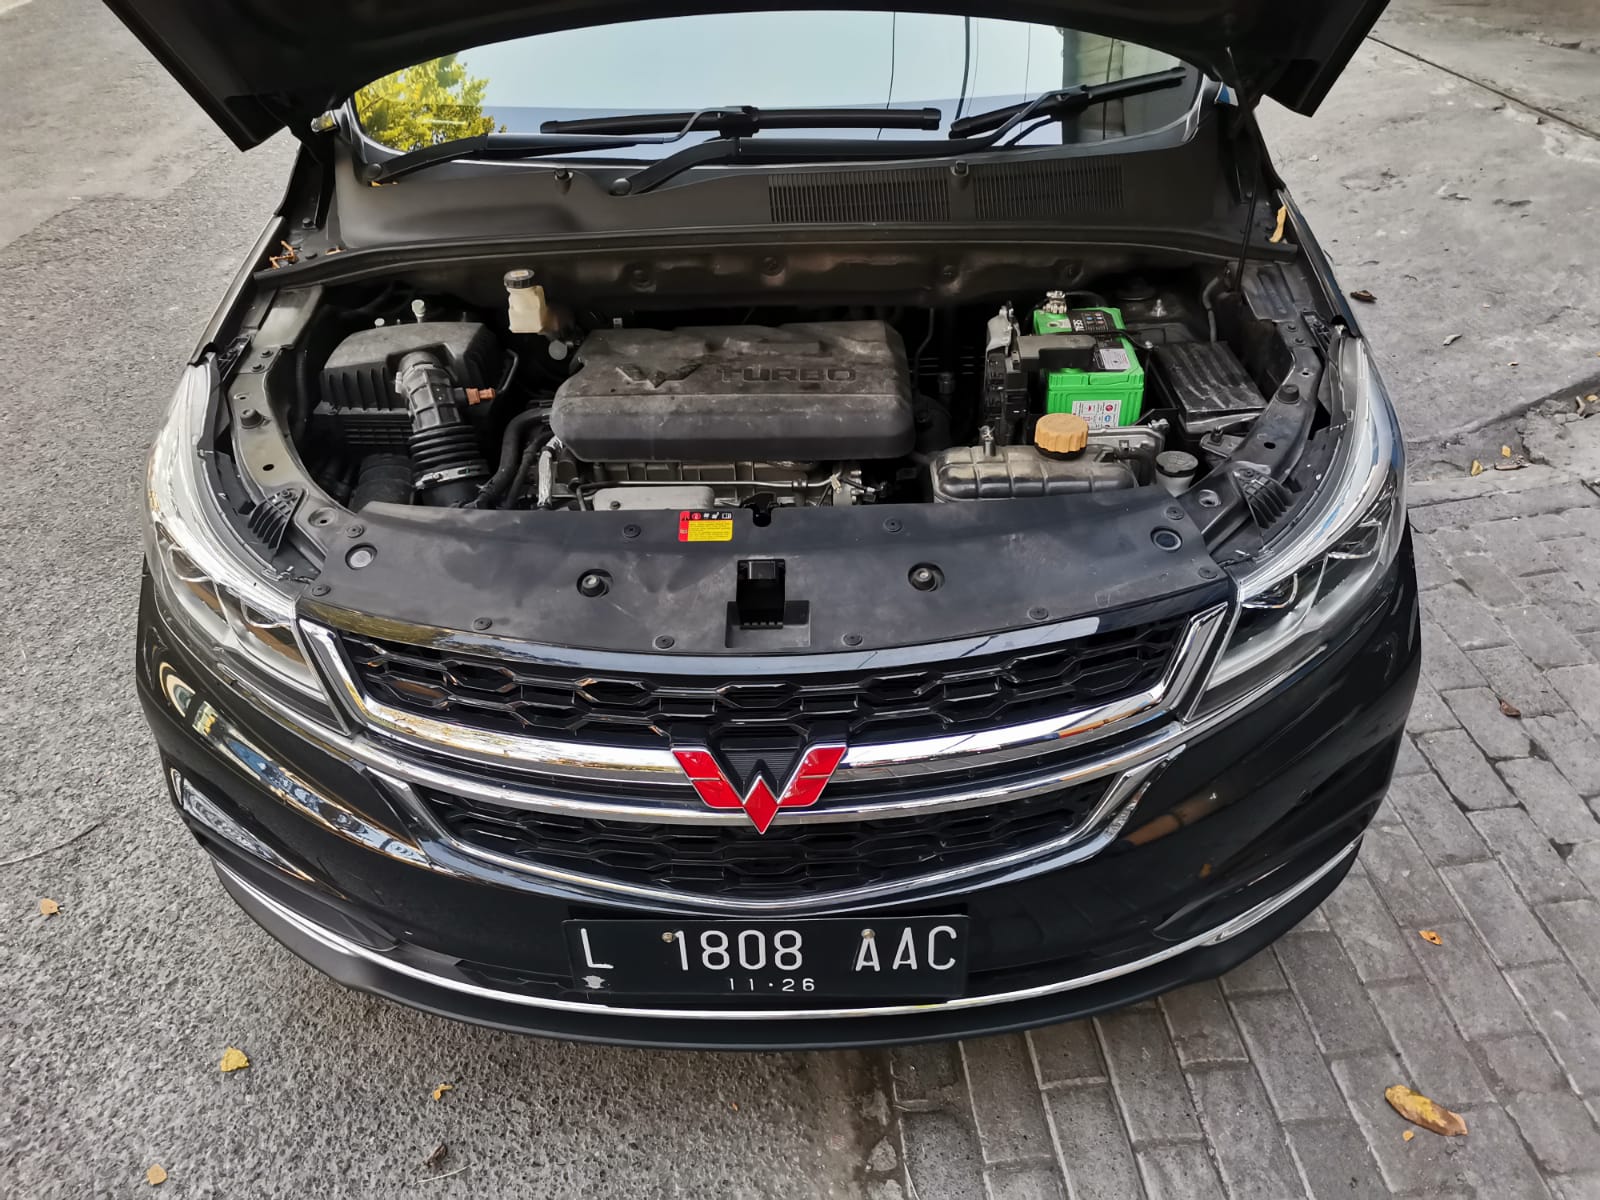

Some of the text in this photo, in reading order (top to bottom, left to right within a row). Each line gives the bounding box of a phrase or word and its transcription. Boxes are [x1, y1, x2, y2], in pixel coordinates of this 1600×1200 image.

[716, 366, 857, 383] TURBO
[580, 925, 957, 972] L 1808 AAC
